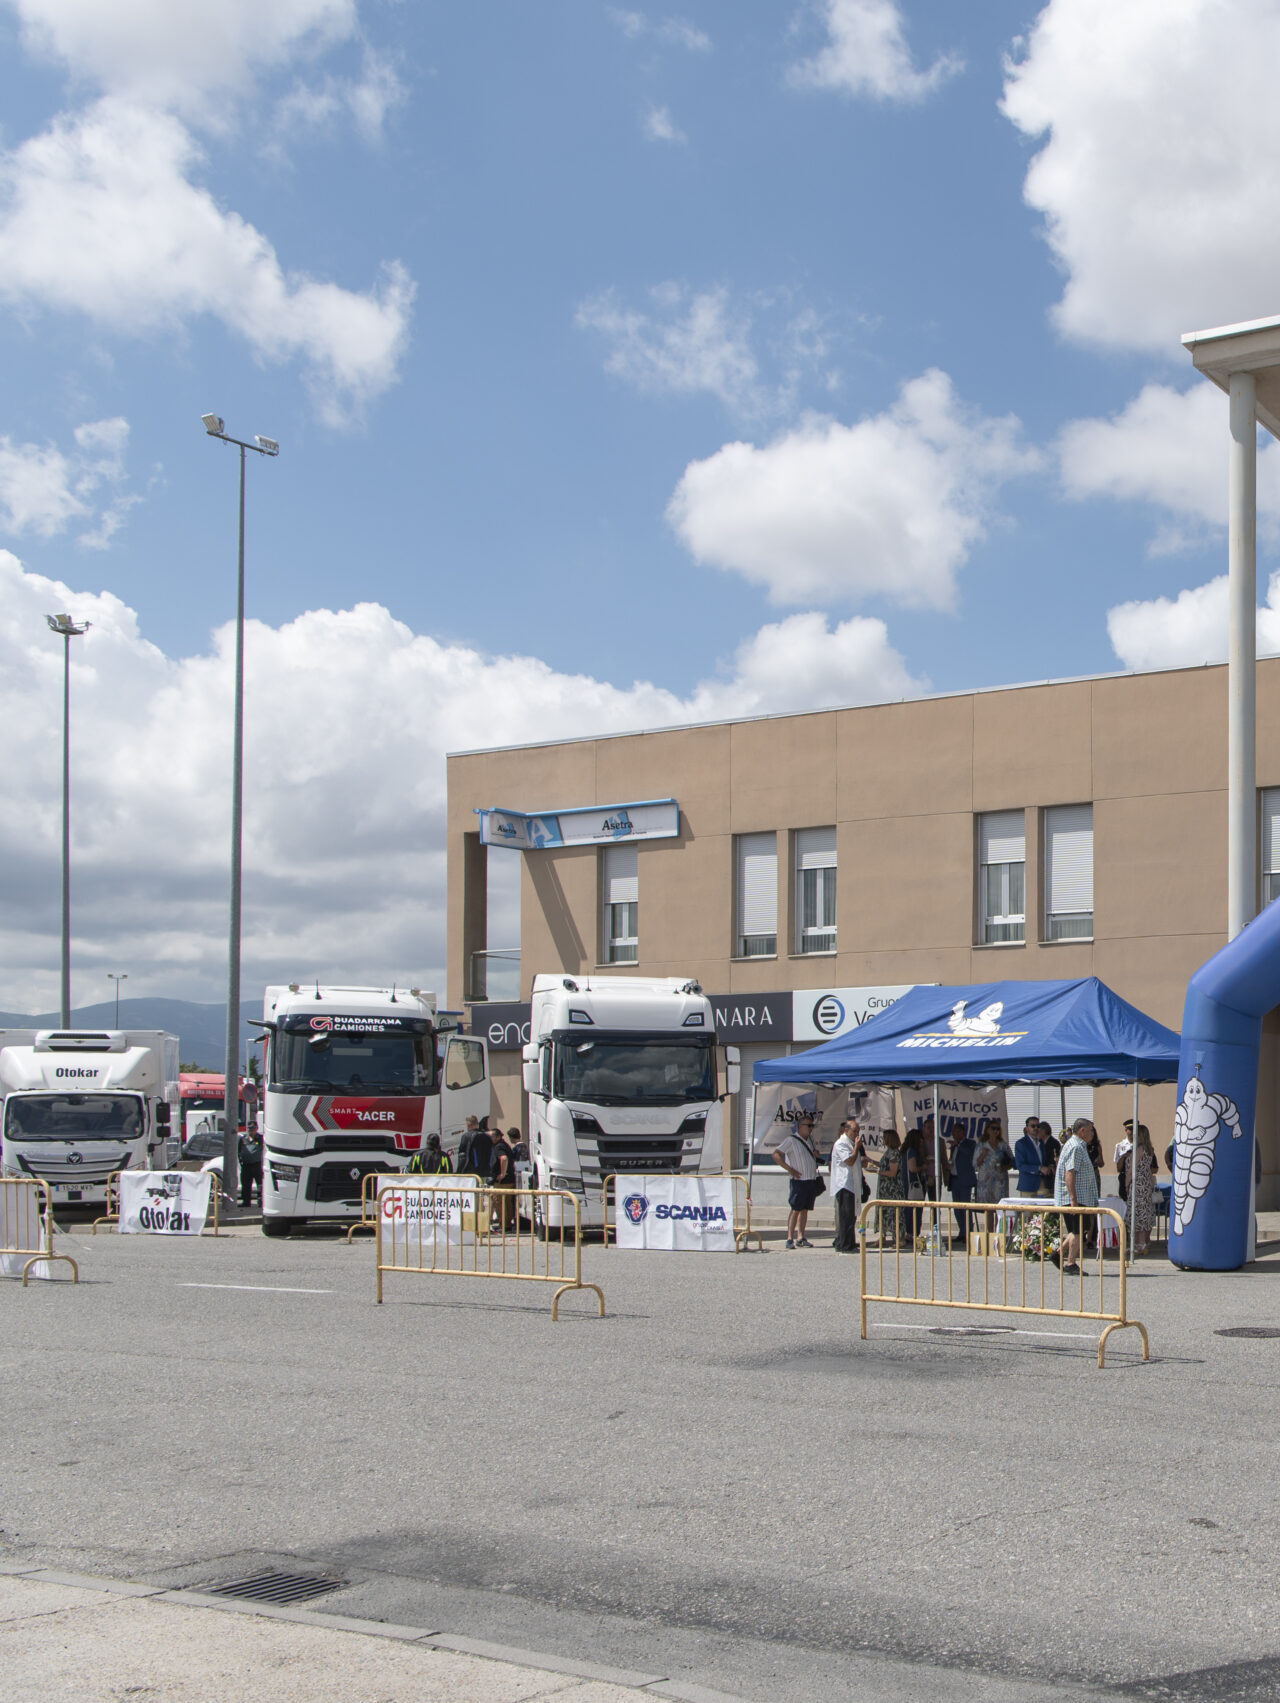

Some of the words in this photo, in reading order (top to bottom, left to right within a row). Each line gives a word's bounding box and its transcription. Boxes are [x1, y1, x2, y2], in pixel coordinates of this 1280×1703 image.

[601, 819, 634, 831] Asetra
[867, 997, 899, 1009] Grup
[334, 1016, 402, 1025] GUADARRAMA
[716, 1006, 773, 1027] NARA
[334, 1024, 385, 1032] CAMIONES
[896, 1037, 1022, 1048] MICHELIN
[55, 1067, 99, 1078] Otokar
[914, 1098, 998, 1114] NEMÁTICOS
[356, 1111, 395, 1121] RACER
[655, 1204, 727, 1221] SCANIA
